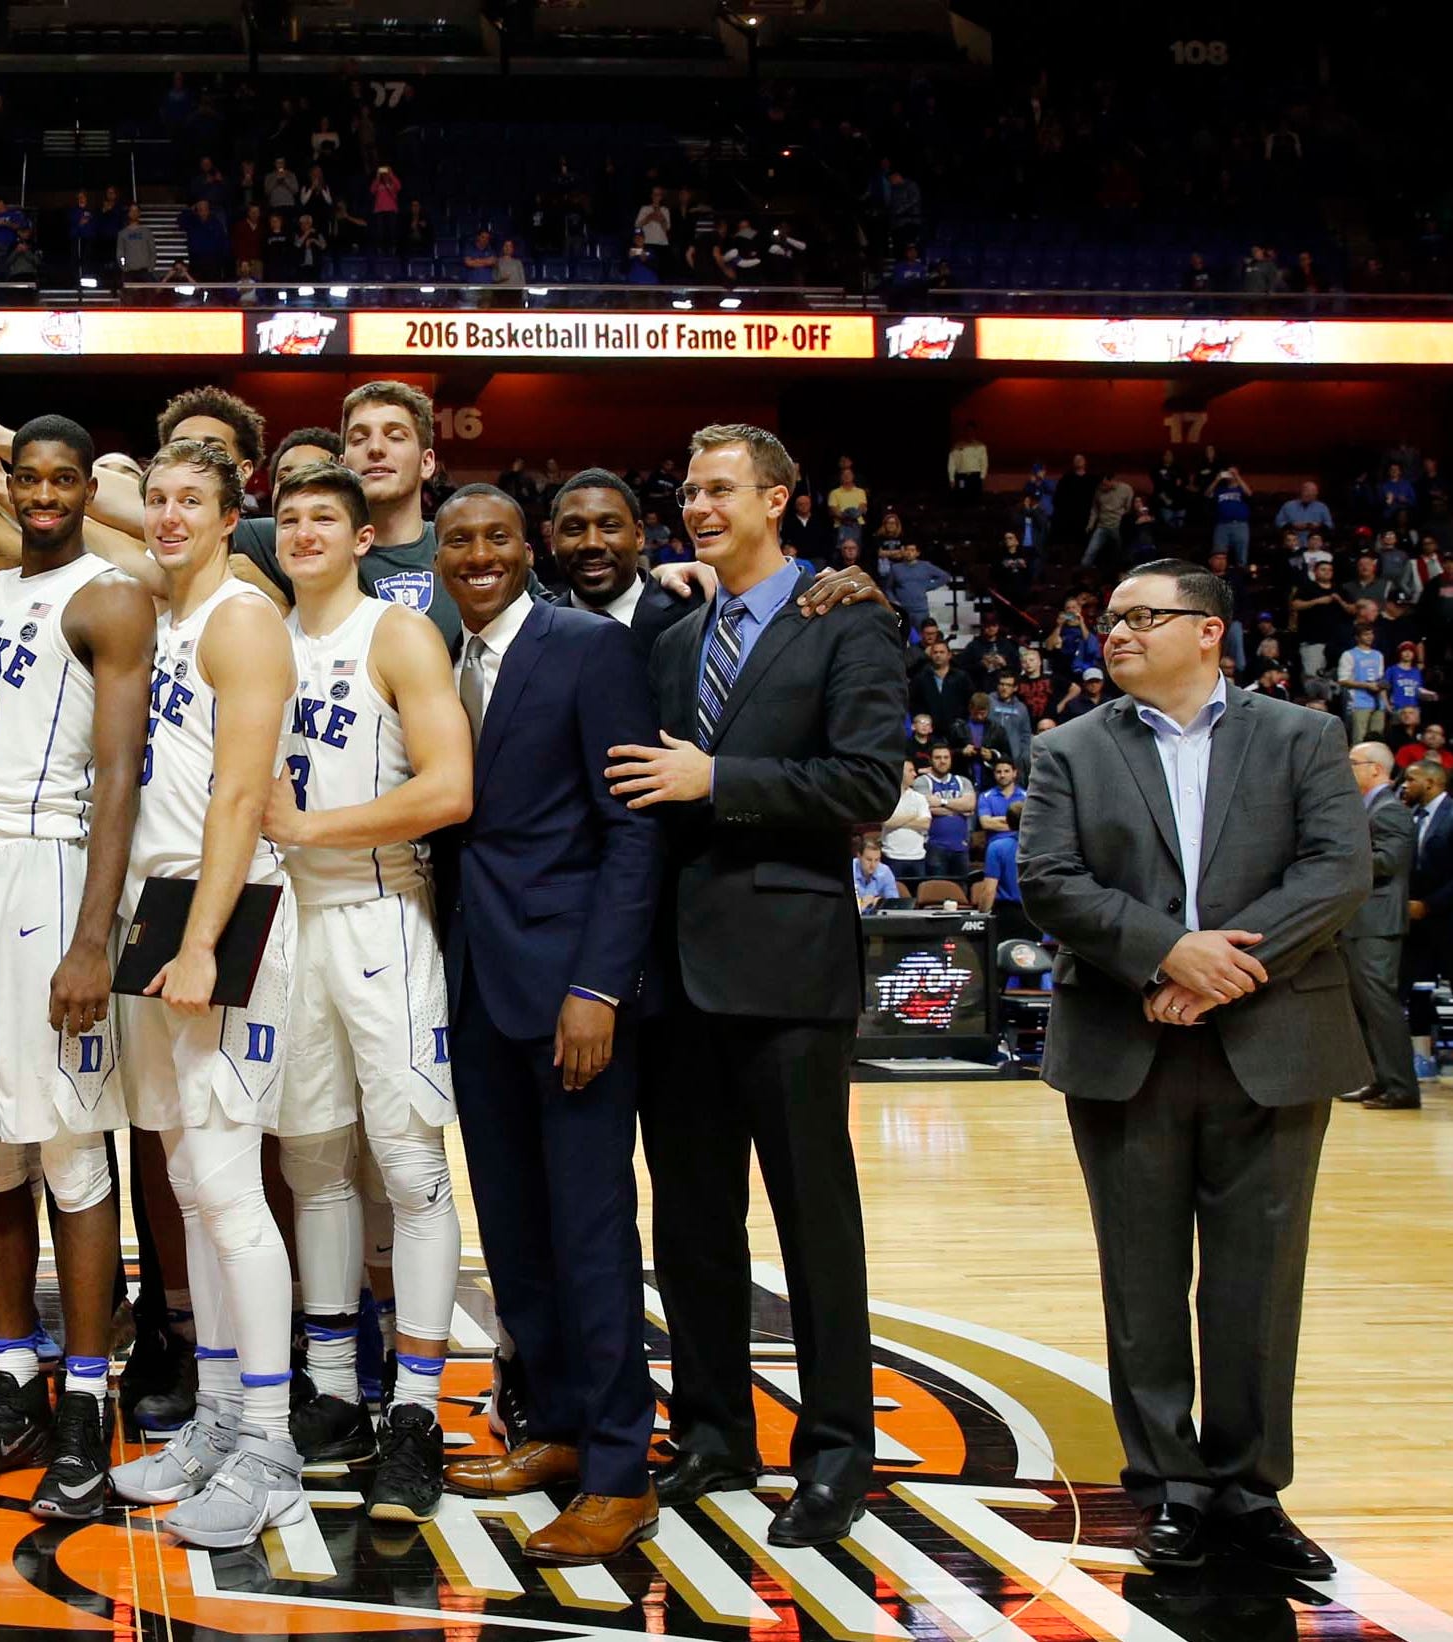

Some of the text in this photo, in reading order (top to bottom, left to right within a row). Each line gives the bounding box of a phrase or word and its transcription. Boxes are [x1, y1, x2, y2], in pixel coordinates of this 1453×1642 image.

[1170, 40, 1227, 66] 108
[406, 321, 459, 347] 2016
[466, 322, 587, 349] Basketball
[595, 323, 639, 349] Hall
[646, 324, 669, 349] of
[676, 324, 737, 349] Fame
[435, 407, 483, 440] 16
[1163, 412, 1208, 444] 17
[149, 667, 195, 728] KE
[292, 697, 358, 750] KE
[961, 921, 985, 931] ANC
